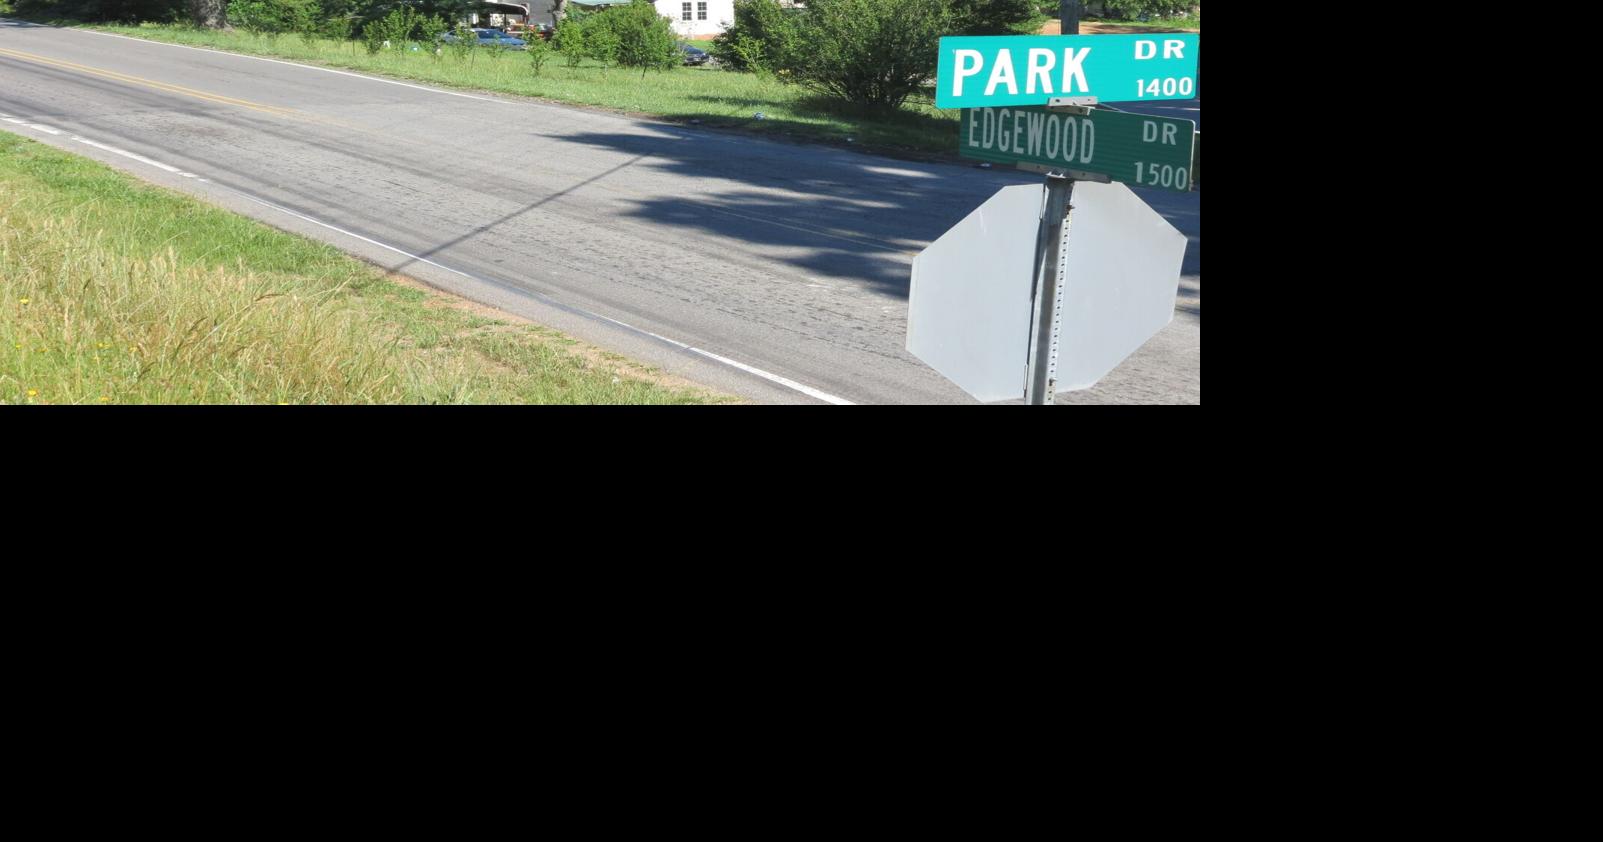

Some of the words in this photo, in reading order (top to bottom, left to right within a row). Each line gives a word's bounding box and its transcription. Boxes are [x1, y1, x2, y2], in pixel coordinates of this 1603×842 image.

[952, 47, 1092, 97] PARK
[1134, 39, 1186, 60] DR
[1135, 76, 1193, 98] 1400
[968, 107, 1095, 164] EDGEWOOD
[1142, 120, 1178, 146] DR
[1133, 161, 1188, 191] 1500
